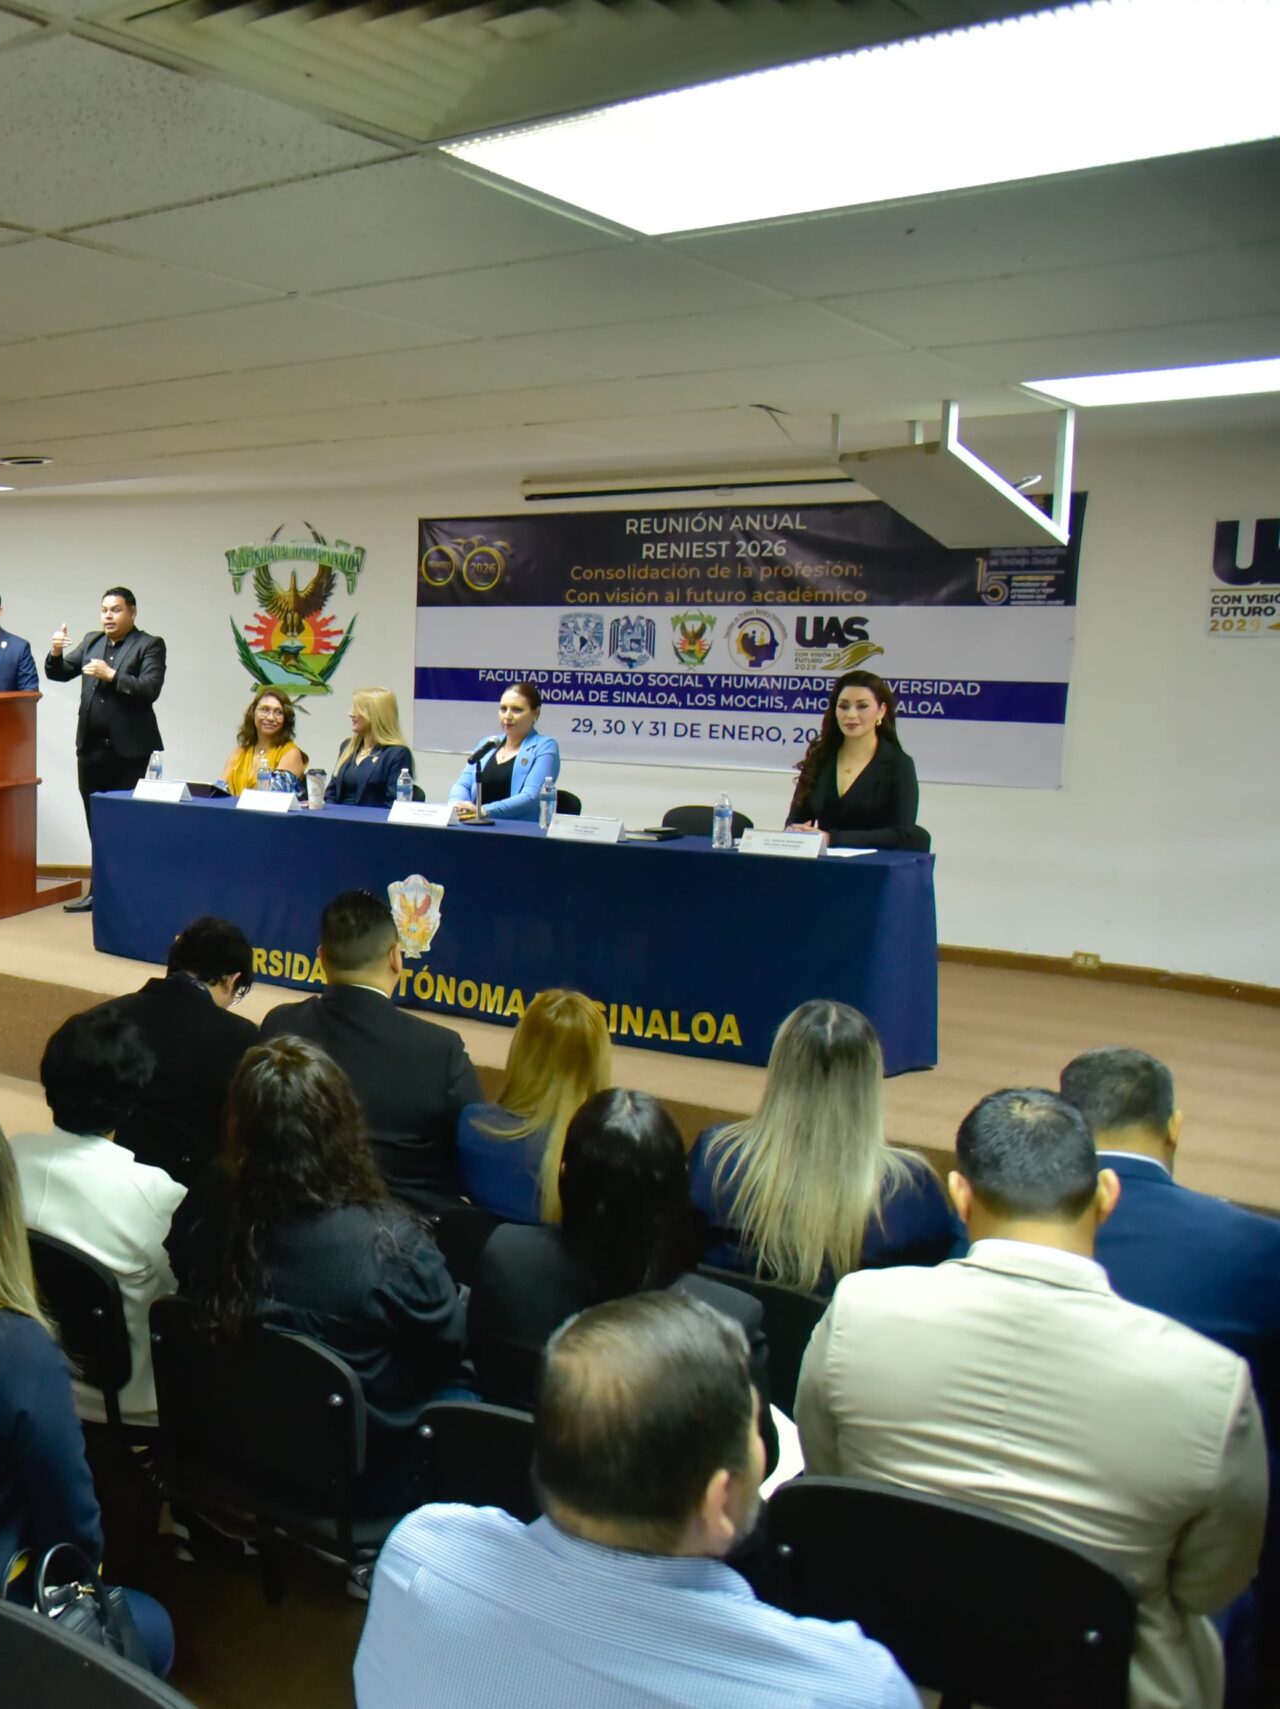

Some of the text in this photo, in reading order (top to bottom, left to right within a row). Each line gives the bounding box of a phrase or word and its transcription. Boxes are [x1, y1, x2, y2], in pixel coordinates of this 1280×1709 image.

[625, 512, 807, 535] REUNIÓN ANUAL
[642, 539, 787, 559] RENIEST 2026
[471, 562, 497, 574] 2026
[570, 560, 864, 581] Consolidación de la profesión:
[565, 584, 867, 604] Con visión al futuro académico
[1211, 593, 1280, 605] CON VISIÓ
[1210, 606, 1276, 617] FUTURO
[795, 616, 869, 648] UAS
[1209, 619, 1261, 632] 2029
[478, 670, 981, 696] FACULTAD DE TRABAJO SOCIAL Y HUMANIDADE VERSIDAD
[588, 690, 609, 702] DE
[613, 691, 682, 708] SINALOA,
[687, 694, 716, 706] LOS
[720, 695, 788, 712] MOCHIS,
[792, 697, 830, 711] AHO
[895, 700, 945, 715] ALOA
[571, 718, 819, 745] 29, 30 Y 31 DE ENERO, 20
[398, 965, 526, 1018] TÓNOMA
[608, 1003, 743, 1046] INALOA
